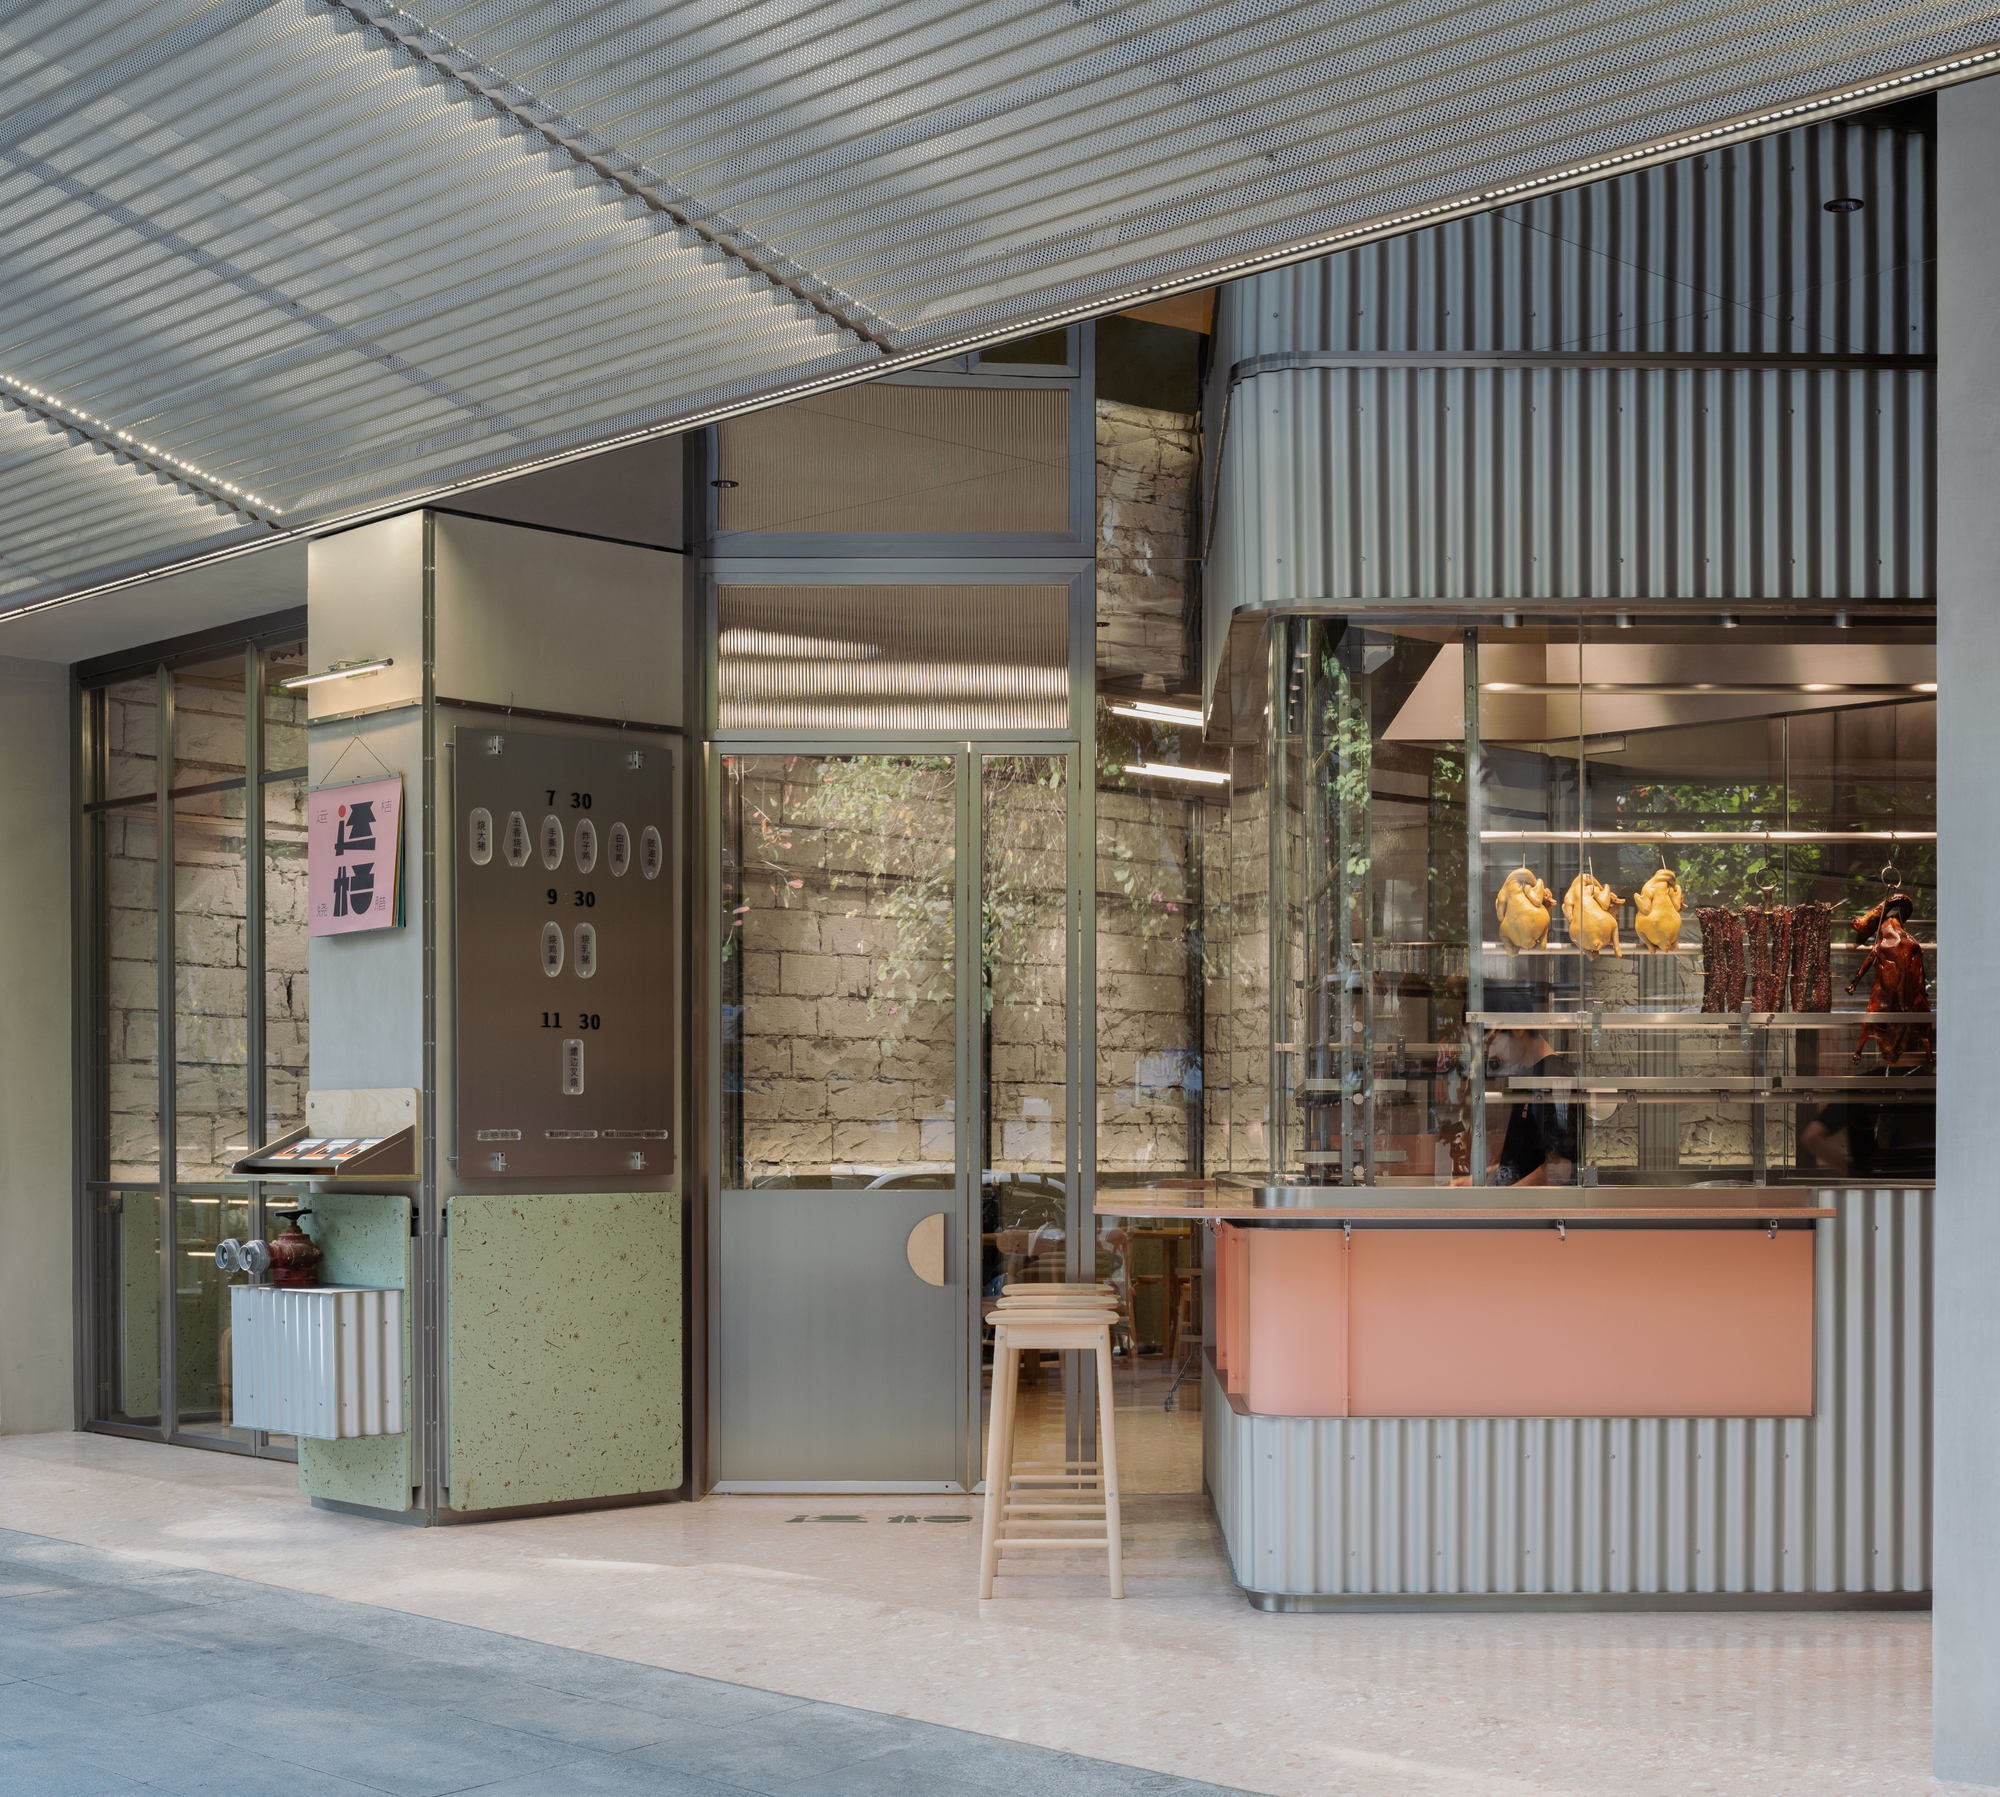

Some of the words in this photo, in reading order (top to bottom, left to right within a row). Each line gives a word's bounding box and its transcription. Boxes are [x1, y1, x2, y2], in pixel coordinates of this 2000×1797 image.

[545, 790, 556, 806] 7
[570, 792, 592, 809] 30
[477, 820, 486, 852] 烧大猪
[548, 828, 557, 859] 手撕鸡
[582, 831, 591, 862] 炸子鸡
[615, 834, 624, 864] 白切鸡
[581, 934, 590, 965] 烧乳猪
[540, 1012, 563, 1029] 11
[579, 1013, 601, 1030] 30
